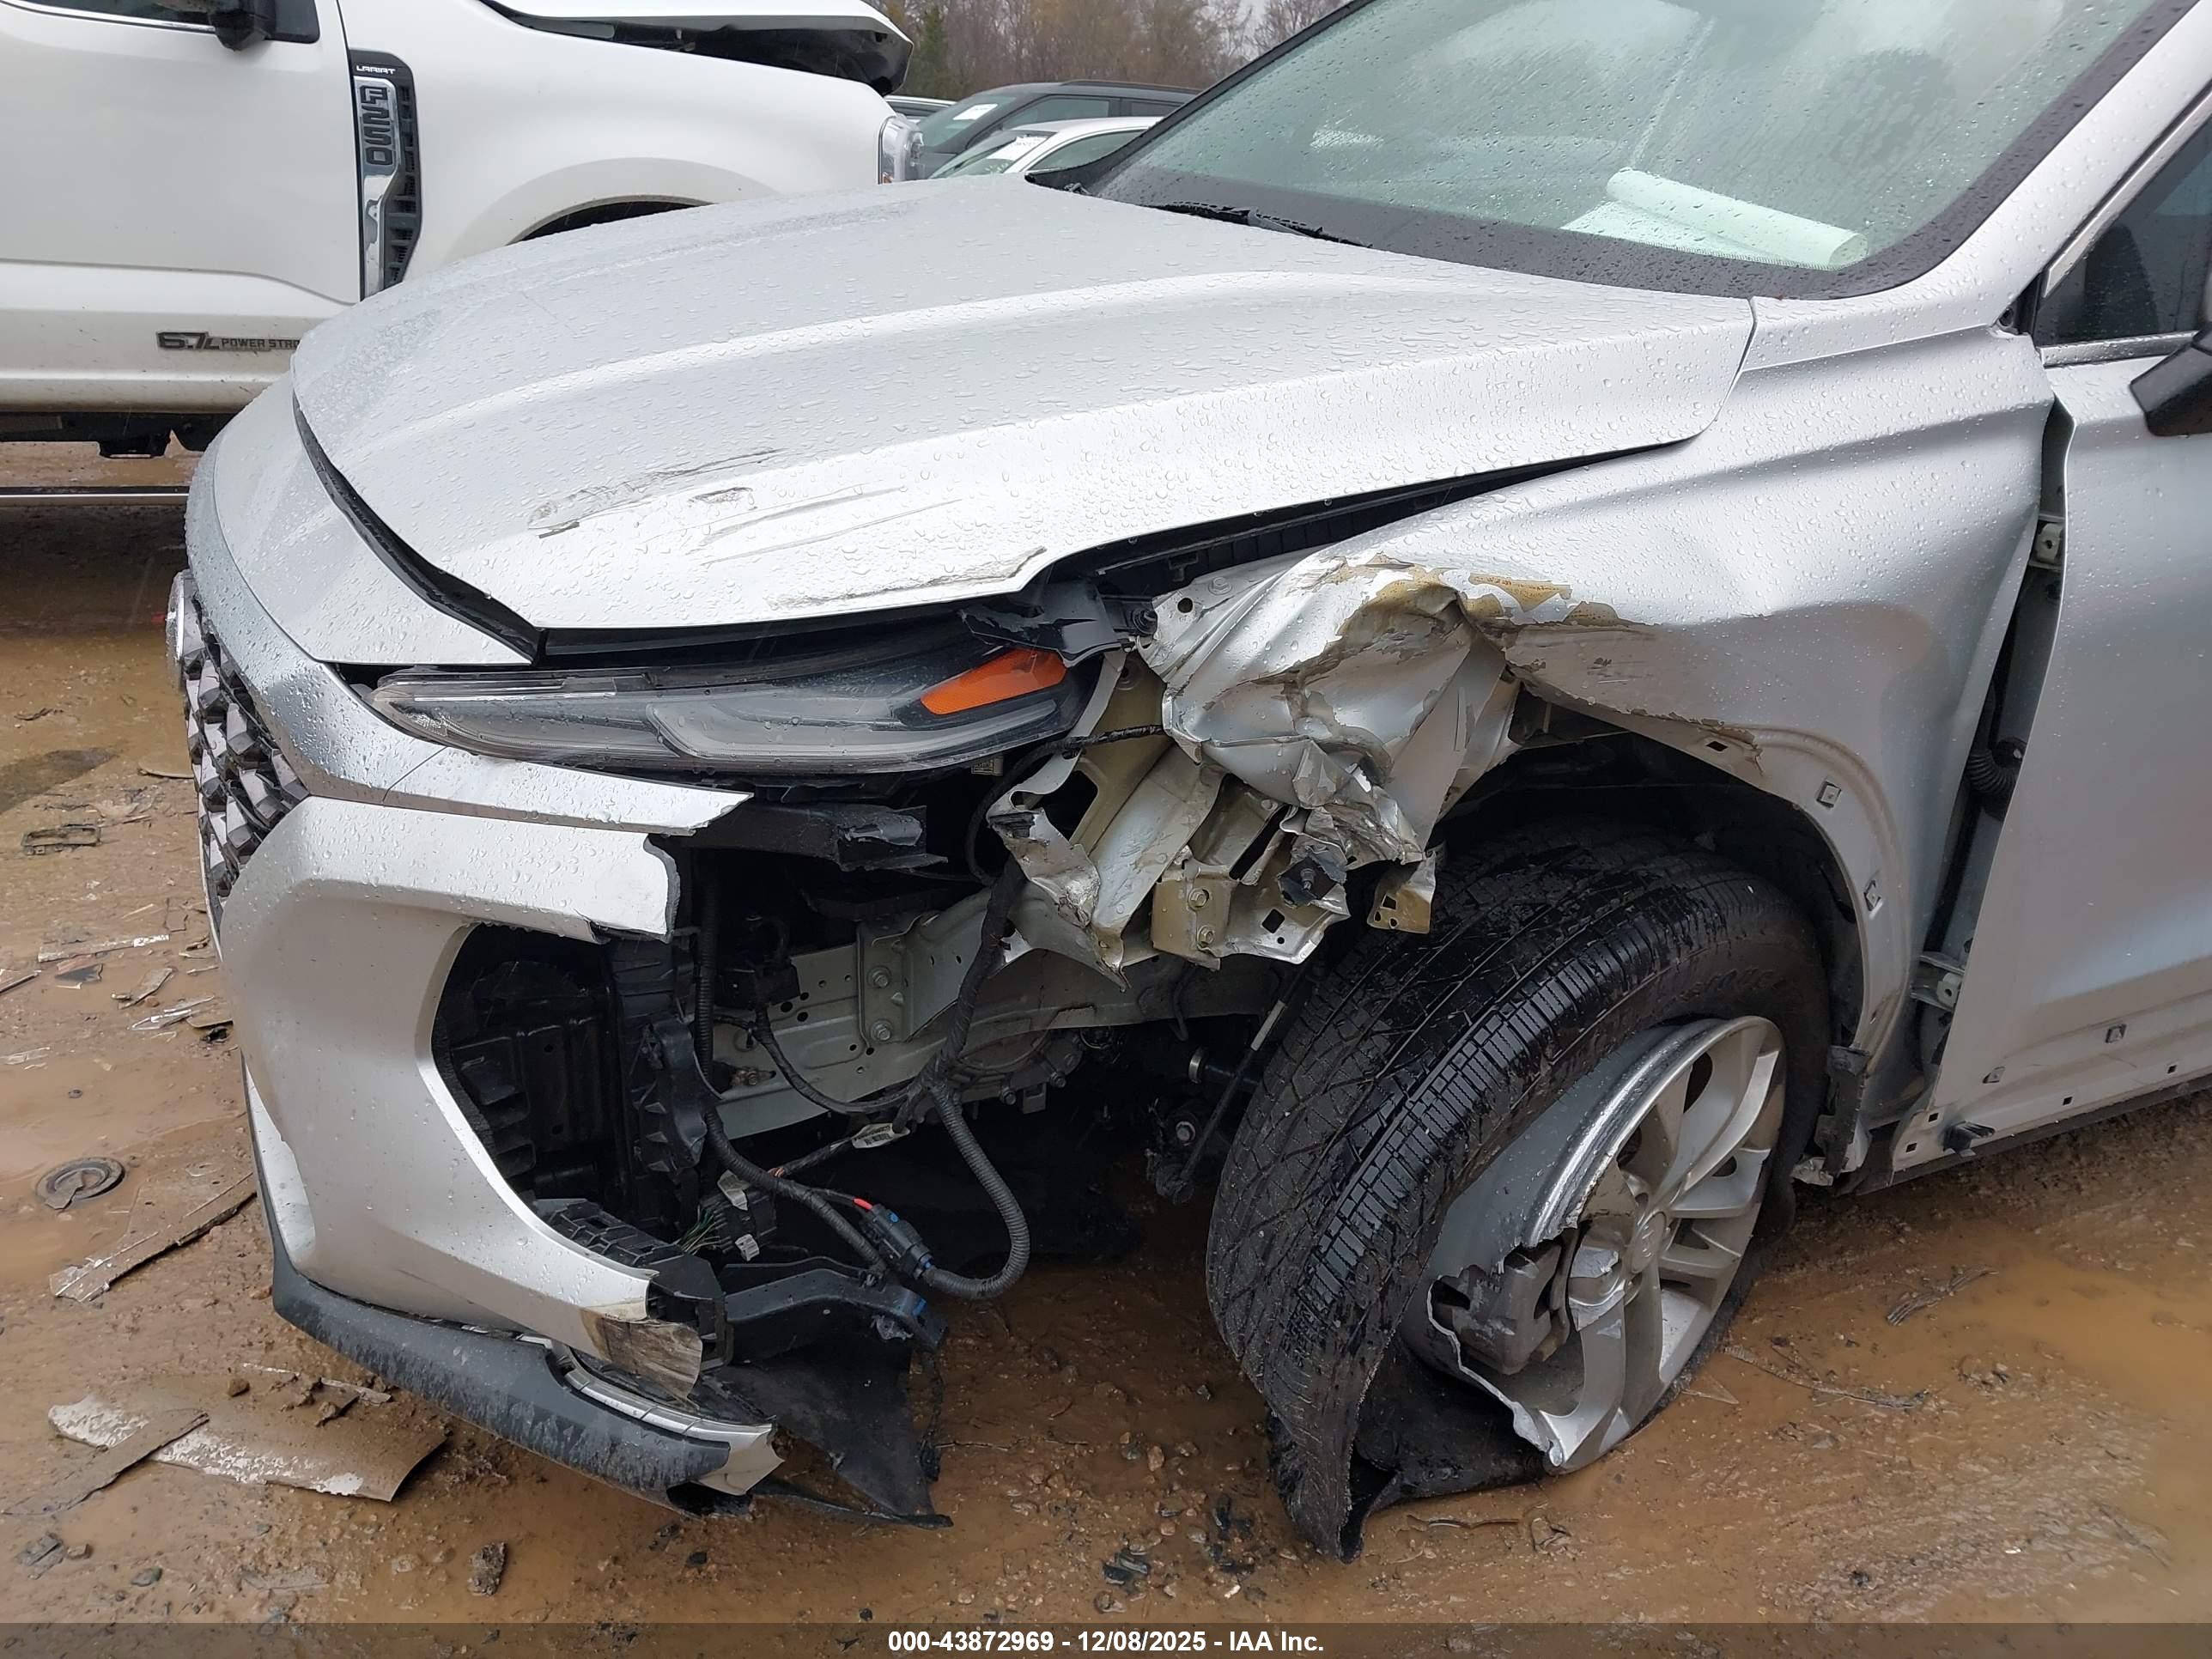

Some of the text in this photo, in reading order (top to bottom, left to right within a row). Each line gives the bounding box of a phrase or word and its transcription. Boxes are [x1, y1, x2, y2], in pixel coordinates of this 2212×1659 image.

[356, 65, 395, 75] LARIAT
[360, 85, 392, 165] F250
[157, 331, 220, 349] 6.7L
[221, 337, 265, 349] POWER
